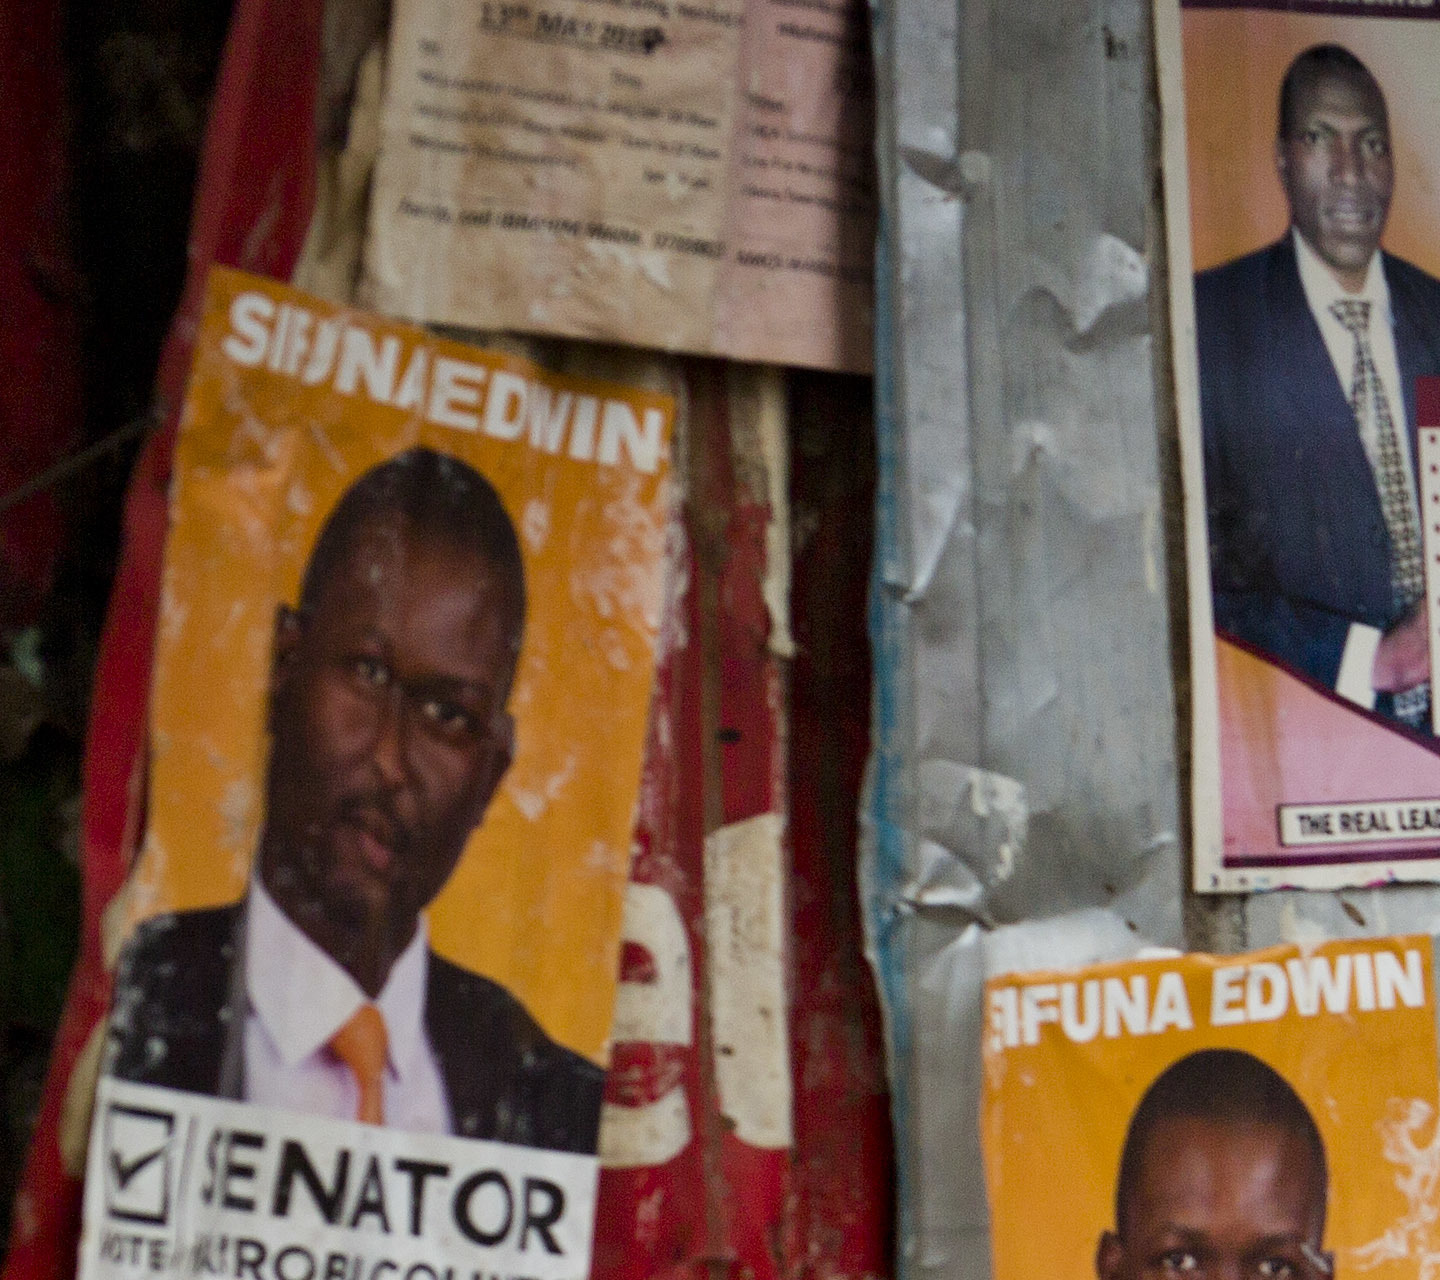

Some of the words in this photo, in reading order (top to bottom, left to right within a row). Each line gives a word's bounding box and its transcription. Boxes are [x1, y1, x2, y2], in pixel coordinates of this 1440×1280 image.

[1298, 811, 1335, 837] THE
[1340, 808, 1390, 834] REAL
[1212, 949, 1426, 1028] EDWIN
